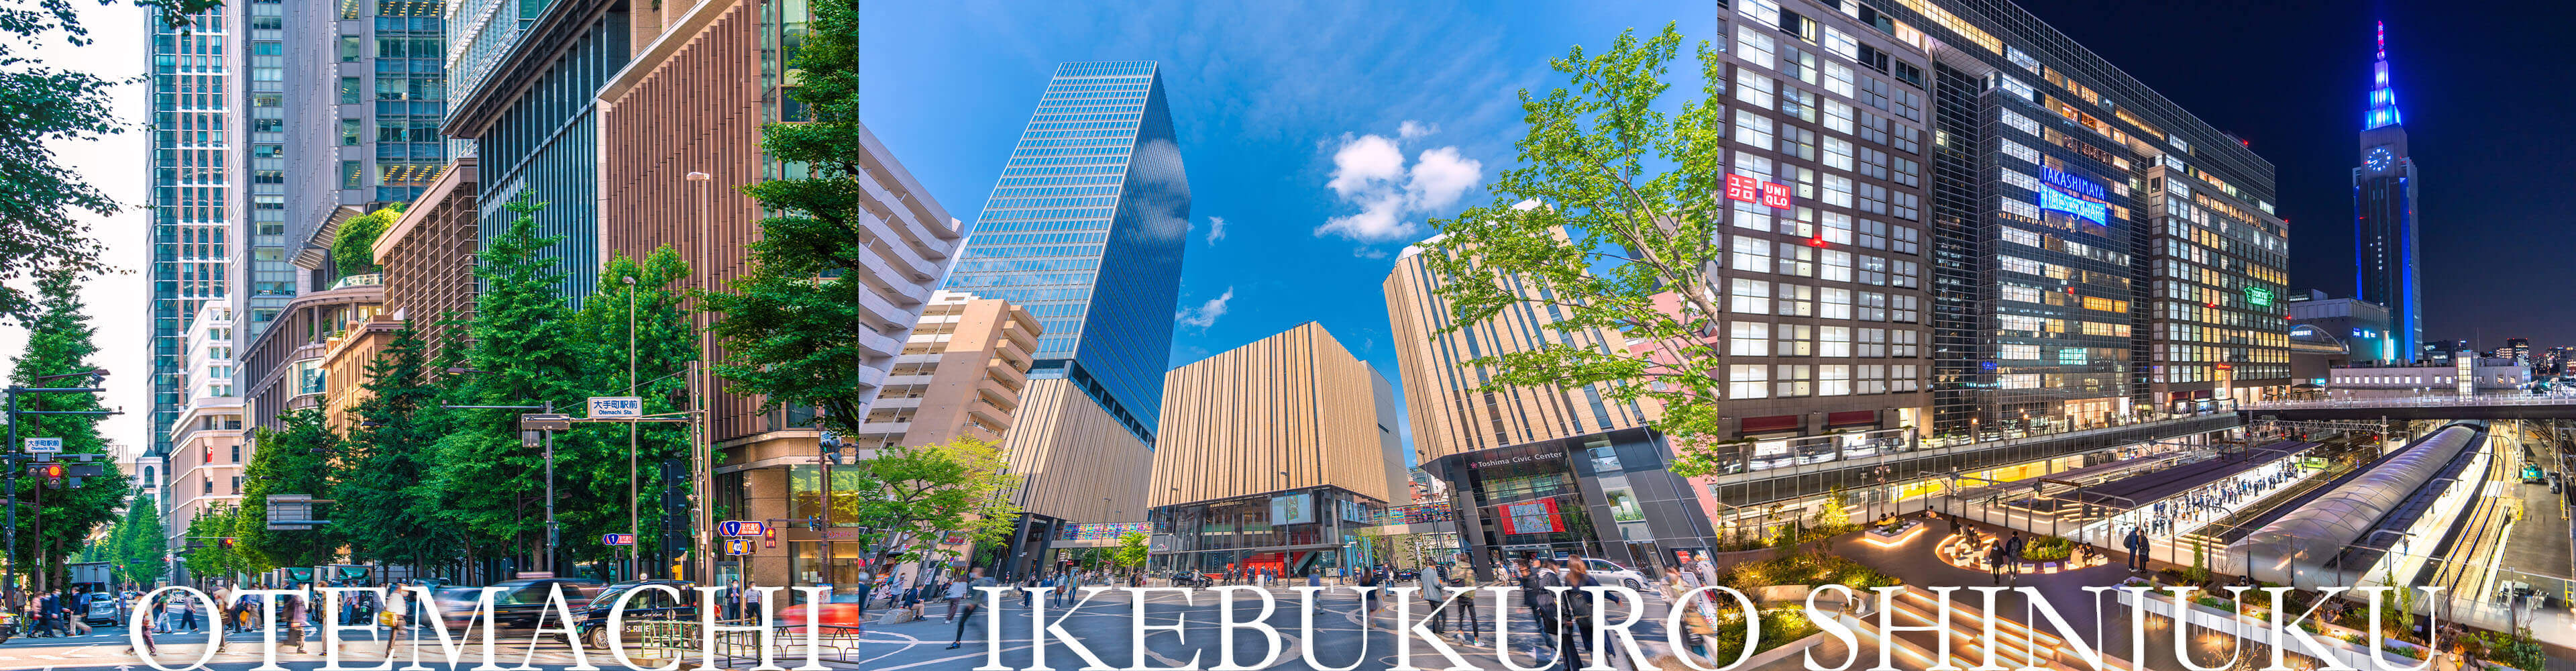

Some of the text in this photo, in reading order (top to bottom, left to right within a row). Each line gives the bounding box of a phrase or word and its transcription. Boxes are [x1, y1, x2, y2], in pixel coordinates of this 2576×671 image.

[2042, 164, 2104, 201] TAKASHIMAYA
[1766, 185, 1786, 197] UNI
[1766, 195, 1788, 207] QLO
[2043, 188, 2104, 221] TIMES SQUARE
[593, 400, 638, 409] 大手町駅前
[1478, 451, 1562, 468] Toshima Civic Center
[730, 523, 735, 533] 1
